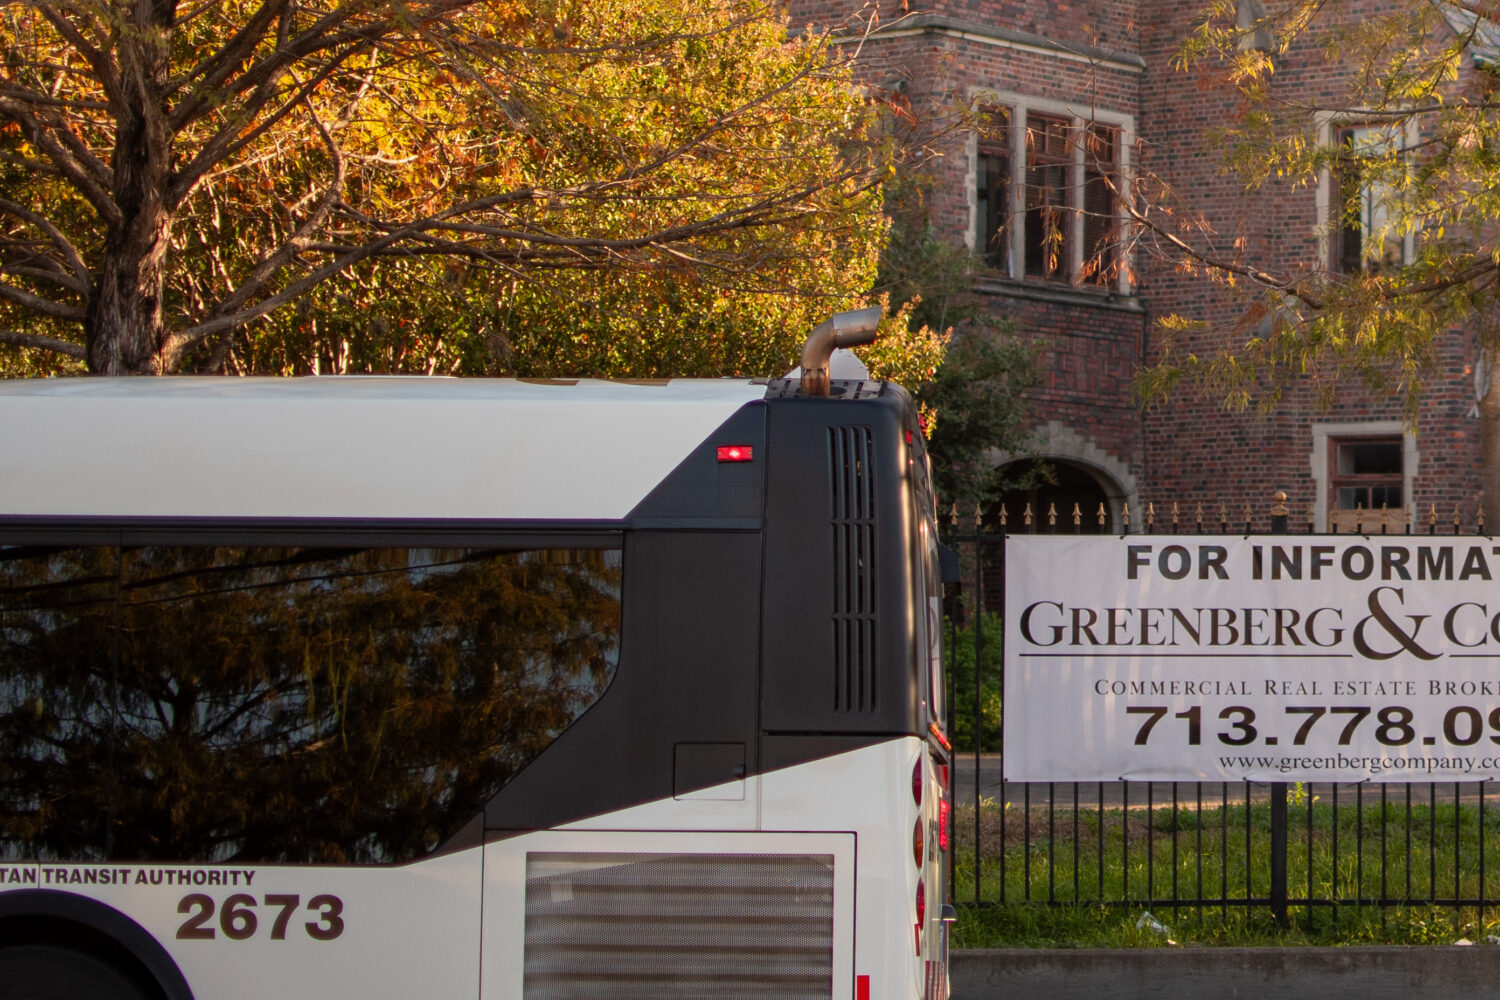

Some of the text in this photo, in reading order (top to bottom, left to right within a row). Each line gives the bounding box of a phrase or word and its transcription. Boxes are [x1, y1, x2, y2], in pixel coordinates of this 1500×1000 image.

[1127, 544, 1230, 581] FOR
[1019, 600, 1345, 648] GREENBERG
[1352, 586, 1445, 661] &
[1094, 679, 1252, 696] COMMERCIAL
[1264, 679, 1323, 696] REAL
[1334, 680, 1416, 696] ESTATE
[42, 868, 132, 885] TRANSIT
[134, 869, 256, 886] AUTHORITY
[175, 893, 345, 941] 2673
